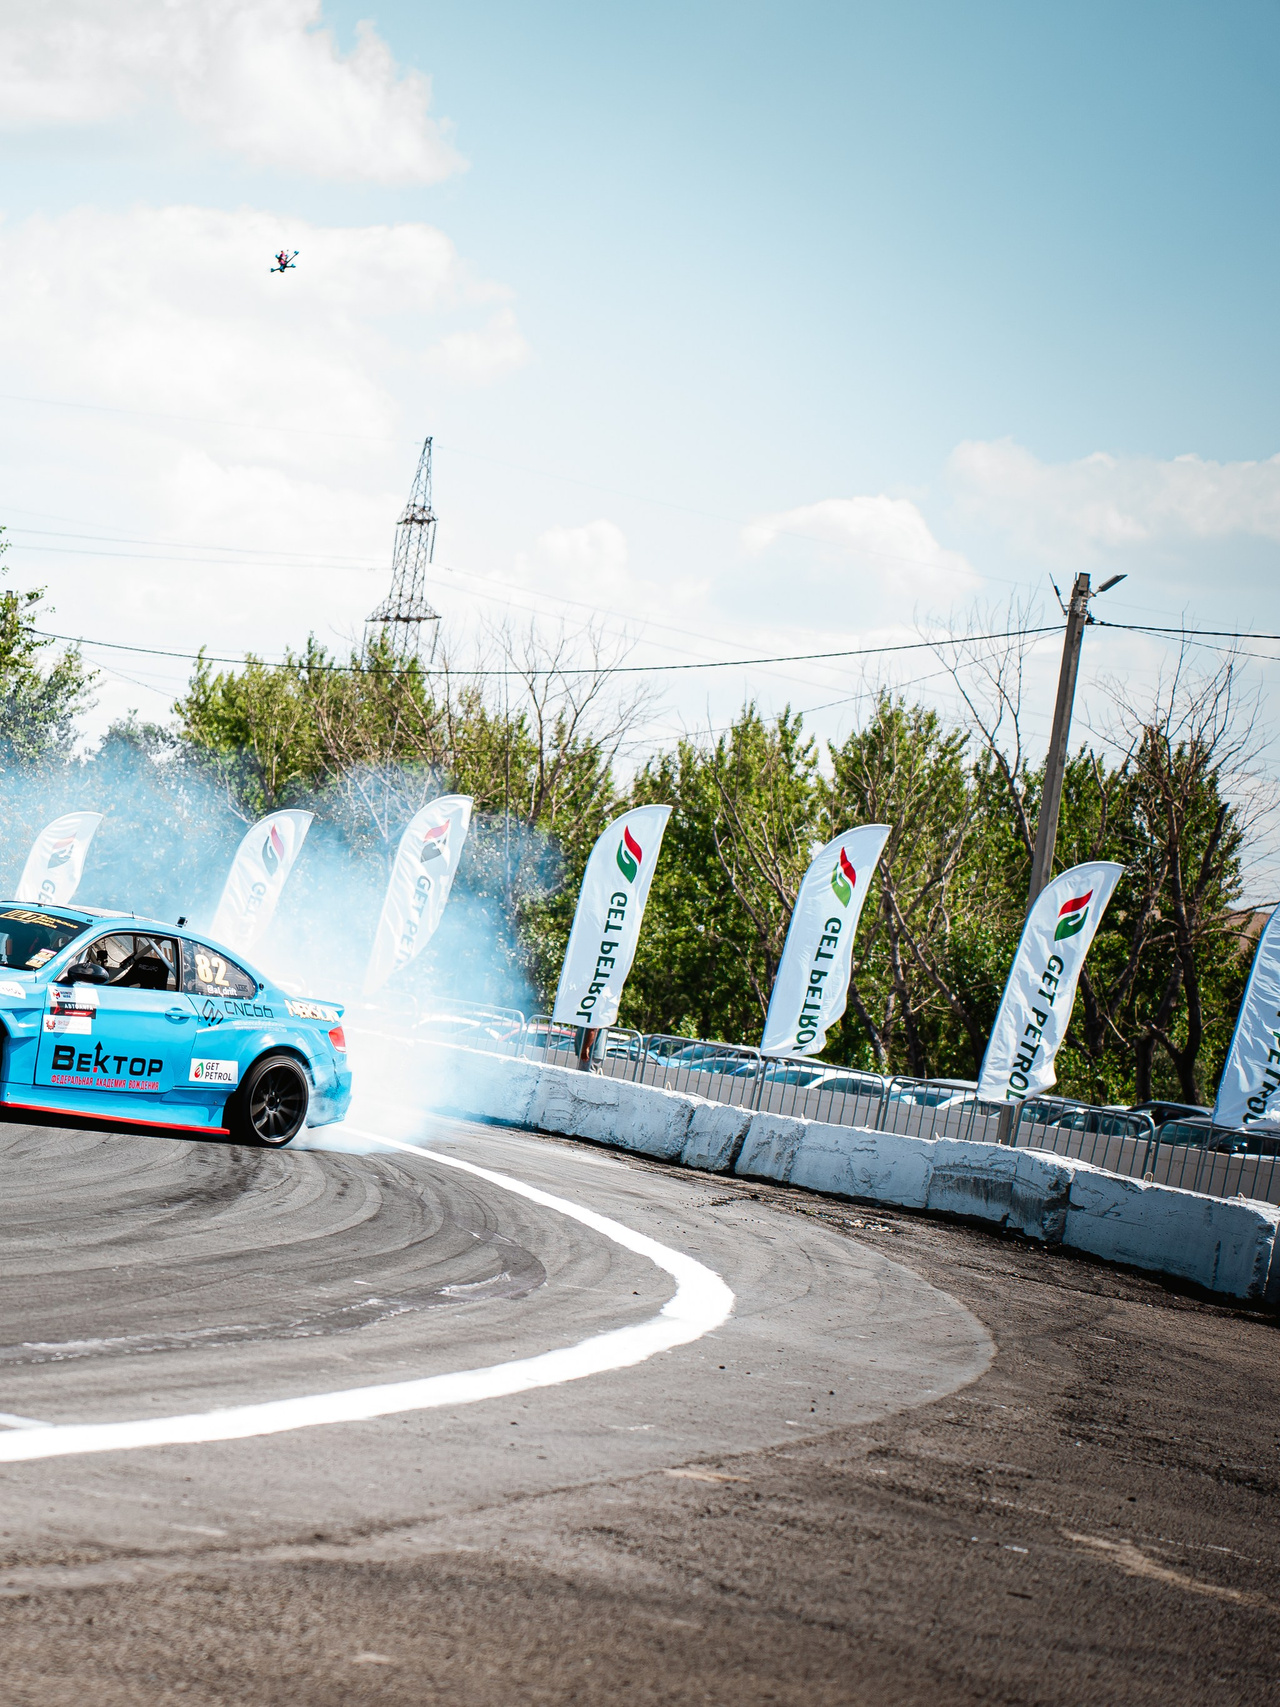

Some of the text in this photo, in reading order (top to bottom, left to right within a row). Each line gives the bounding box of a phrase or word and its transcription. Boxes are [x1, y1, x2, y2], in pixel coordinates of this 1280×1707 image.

[38, 879, 56, 904] GE
[412, 875, 431, 918] GET
[194, 953, 230, 987] 82
[223, 1000, 275, 1019] CNC66
[1005, 954, 1065, 1102] GET PETROL
[51, 1041, 164, 1077] ВЕКТОР
[205, 1062, 220, 1071] GET
[51, 1074, 159, 1091] ФЕДЕРАЛЬНАЯ АКАДЕМИЯ ВОЖДЕНИЯ
[204, 1071, 233, 1081] PETROL
